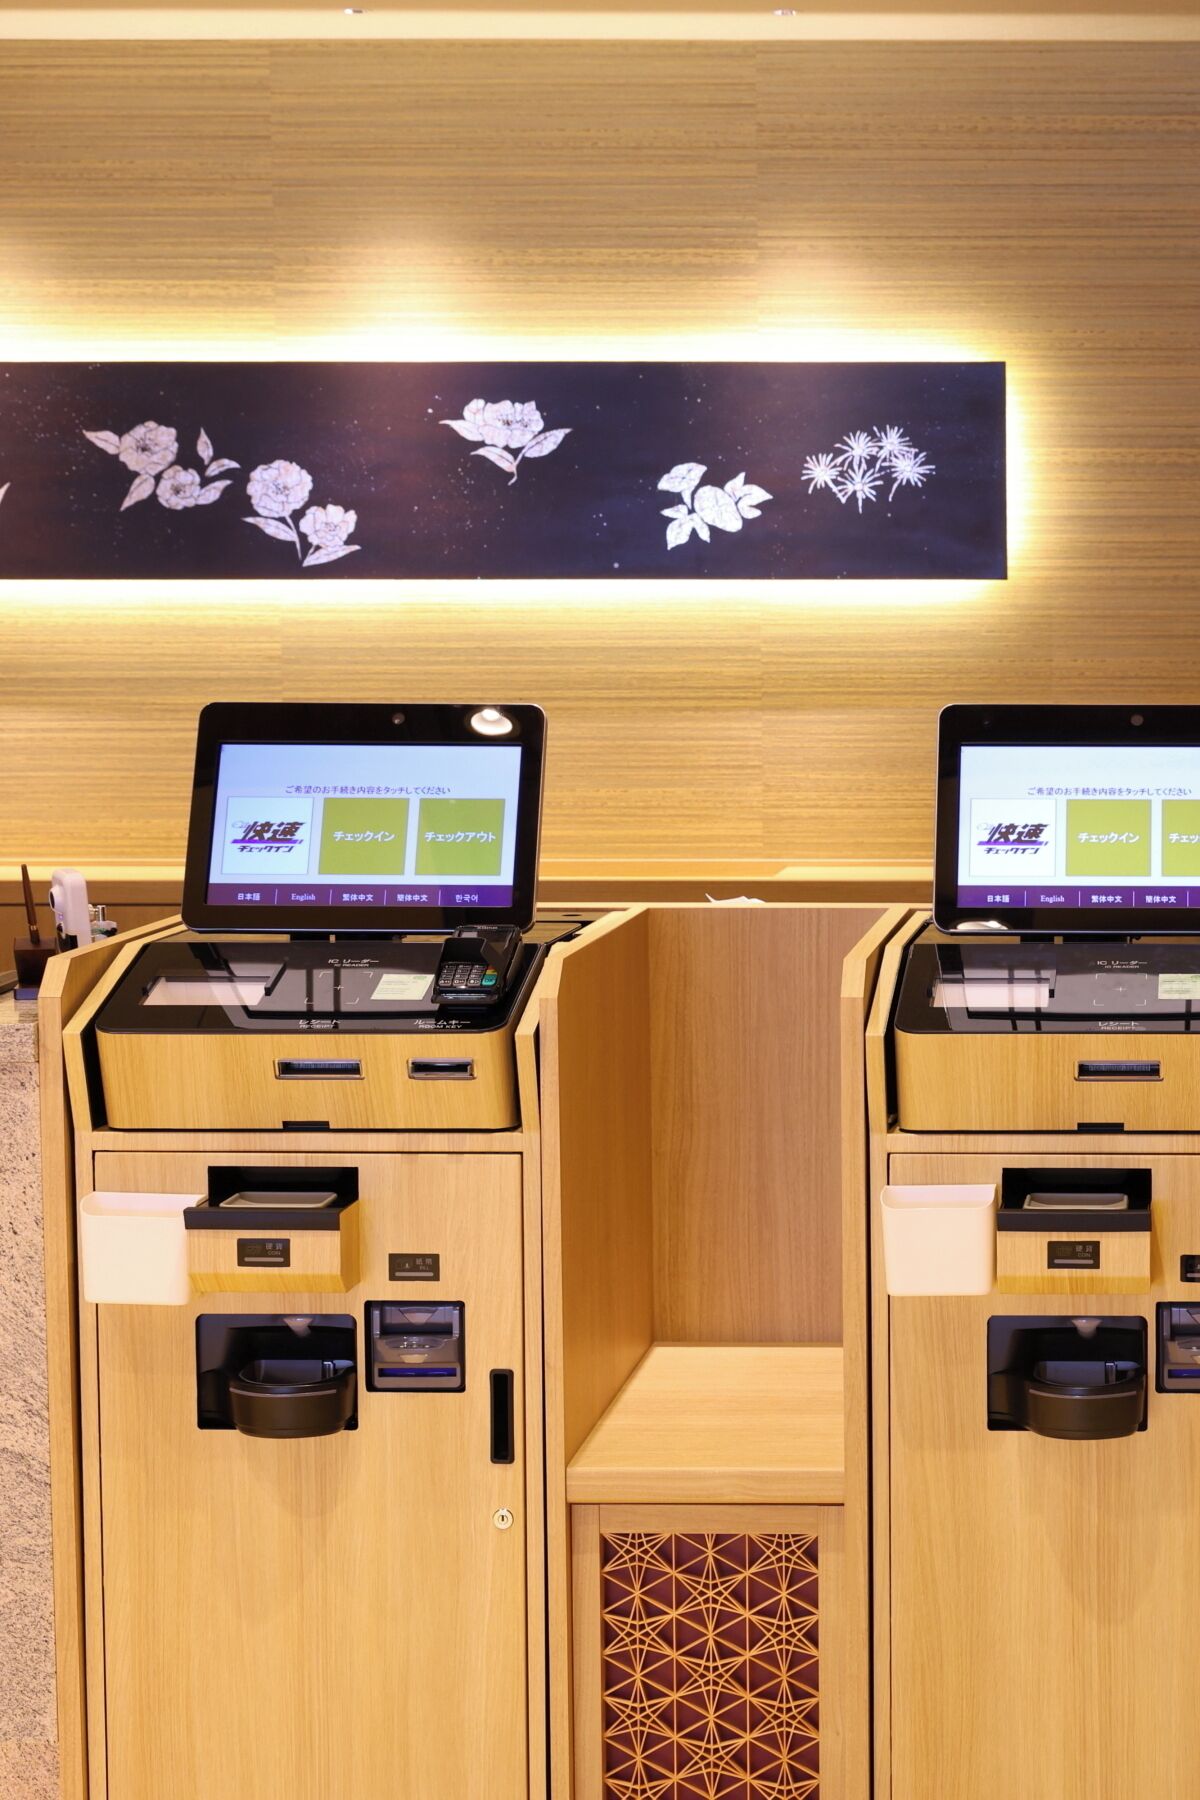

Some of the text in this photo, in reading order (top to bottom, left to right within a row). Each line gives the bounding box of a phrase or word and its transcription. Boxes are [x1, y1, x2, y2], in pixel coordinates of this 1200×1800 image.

[285, 784, 451, 795] ご希望のお手続き内容をタッチしてください
[1028, 786, 1192, 796] ご希望のお手続き内容をタッチしてください
[241, 821, 305, 842] 快速
[987, 822, 1049, 843] 快速
[333, 831, 395, 843] チェックイン
[425, 831, 496, 843] チェックアウト
[1078, 832, 1139, 844] チェックイン
[237, 845, 295, 853] チェックイン
[983, 846, 1040, 855] チェックイン
[237, 892, 261, 901] 日本語
[291, 893, 316, 902] English
[455, 894, 479, 903] 한국어
[987, 895, 1010, 903] 日本語
[1040, 895, 1065, 903] English
